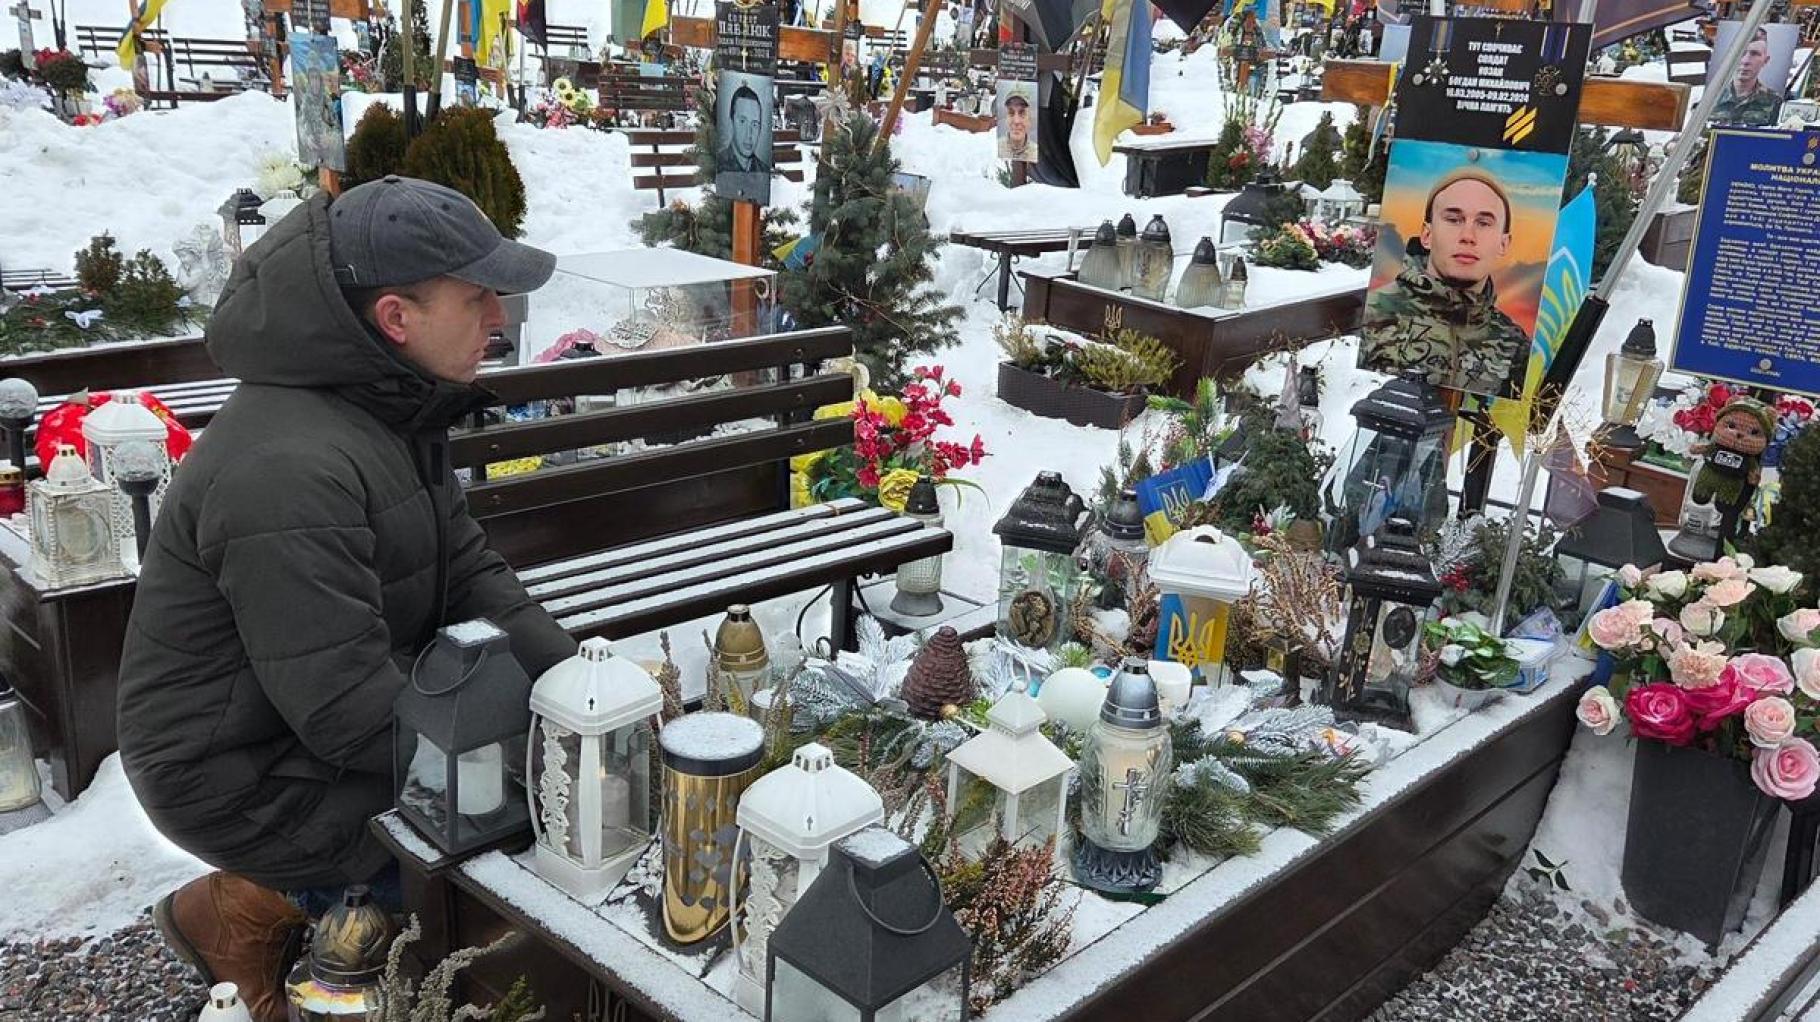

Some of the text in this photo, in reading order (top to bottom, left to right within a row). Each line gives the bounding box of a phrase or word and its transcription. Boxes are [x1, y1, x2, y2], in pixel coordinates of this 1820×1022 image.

[1468, 41, 1482, 51] ТУТ
[1477, 53, 1509, 65] СОЛДАТ
[1448, 75, 1478, 87] БОГДАН
[1751, 163, 1794, 173] МОЛИТВА
